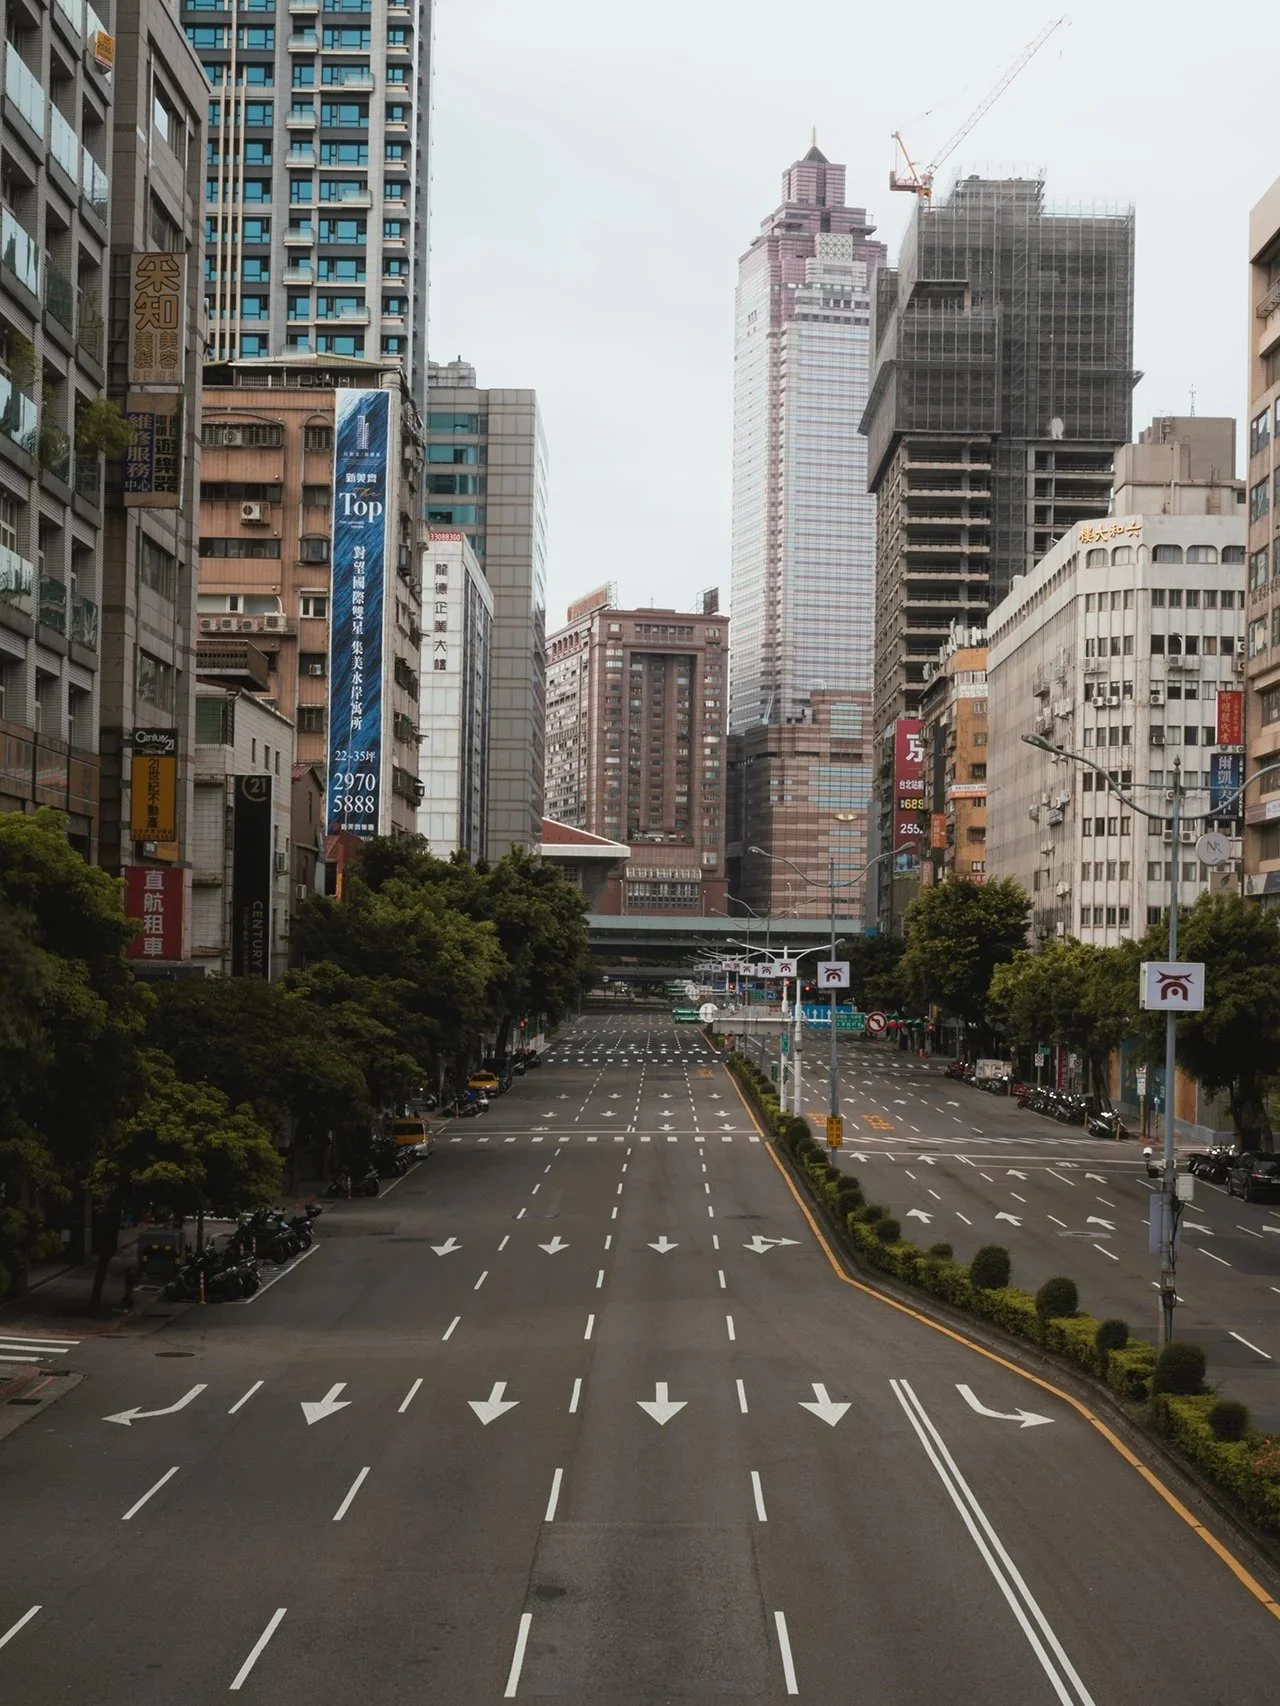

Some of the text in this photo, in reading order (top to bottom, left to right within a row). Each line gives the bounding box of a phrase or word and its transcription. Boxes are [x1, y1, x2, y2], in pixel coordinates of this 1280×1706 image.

[159, 331, 179, 370] 美容
[338, 492, 383, 523] Top
[249, 777, 267, 793] 21
[333, 772, 376, 791] 2970
[332, 795, 375, 813] 5888
[143, 870, 164, 957] 直航租車
[252, 900, 263, 969] CENTURY
